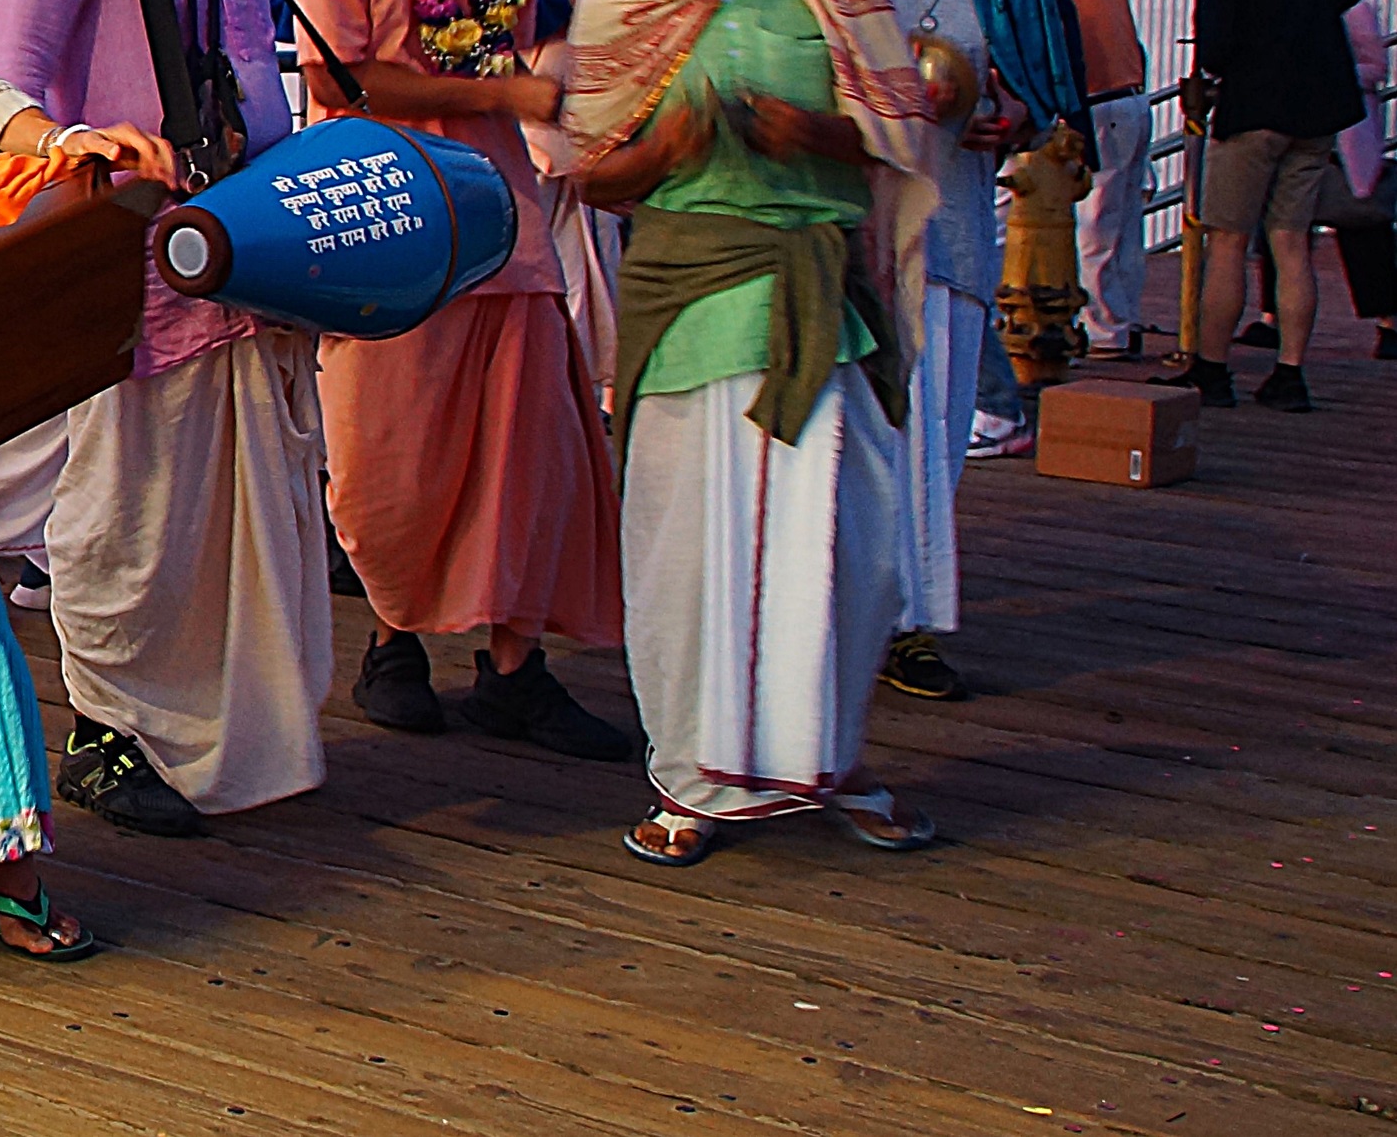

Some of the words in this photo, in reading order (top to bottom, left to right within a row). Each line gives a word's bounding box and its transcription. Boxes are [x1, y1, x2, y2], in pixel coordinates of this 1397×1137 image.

[271, 175, 298, 193] हरे
[297, 167, 340, 189] कृष्ण
[336, 158, 363, 177] हरे
[359, 151, 398, 174] कृष्ण
[279, 191, 324, 216] कृष्ण
[320, 182, 363, 206] कृष्ण
[361, 173, 387, 193] हरे
[306, 207, 330, 230] हरे
[330, 204, 361, 224] राम
[360, 195, 383, 218] हरे
[383, 192, 412, 211] राम
[307, 234, 336, 254] राम
[338, 227, 366, 246] राम
[368, 218, 389, 241] हरे
